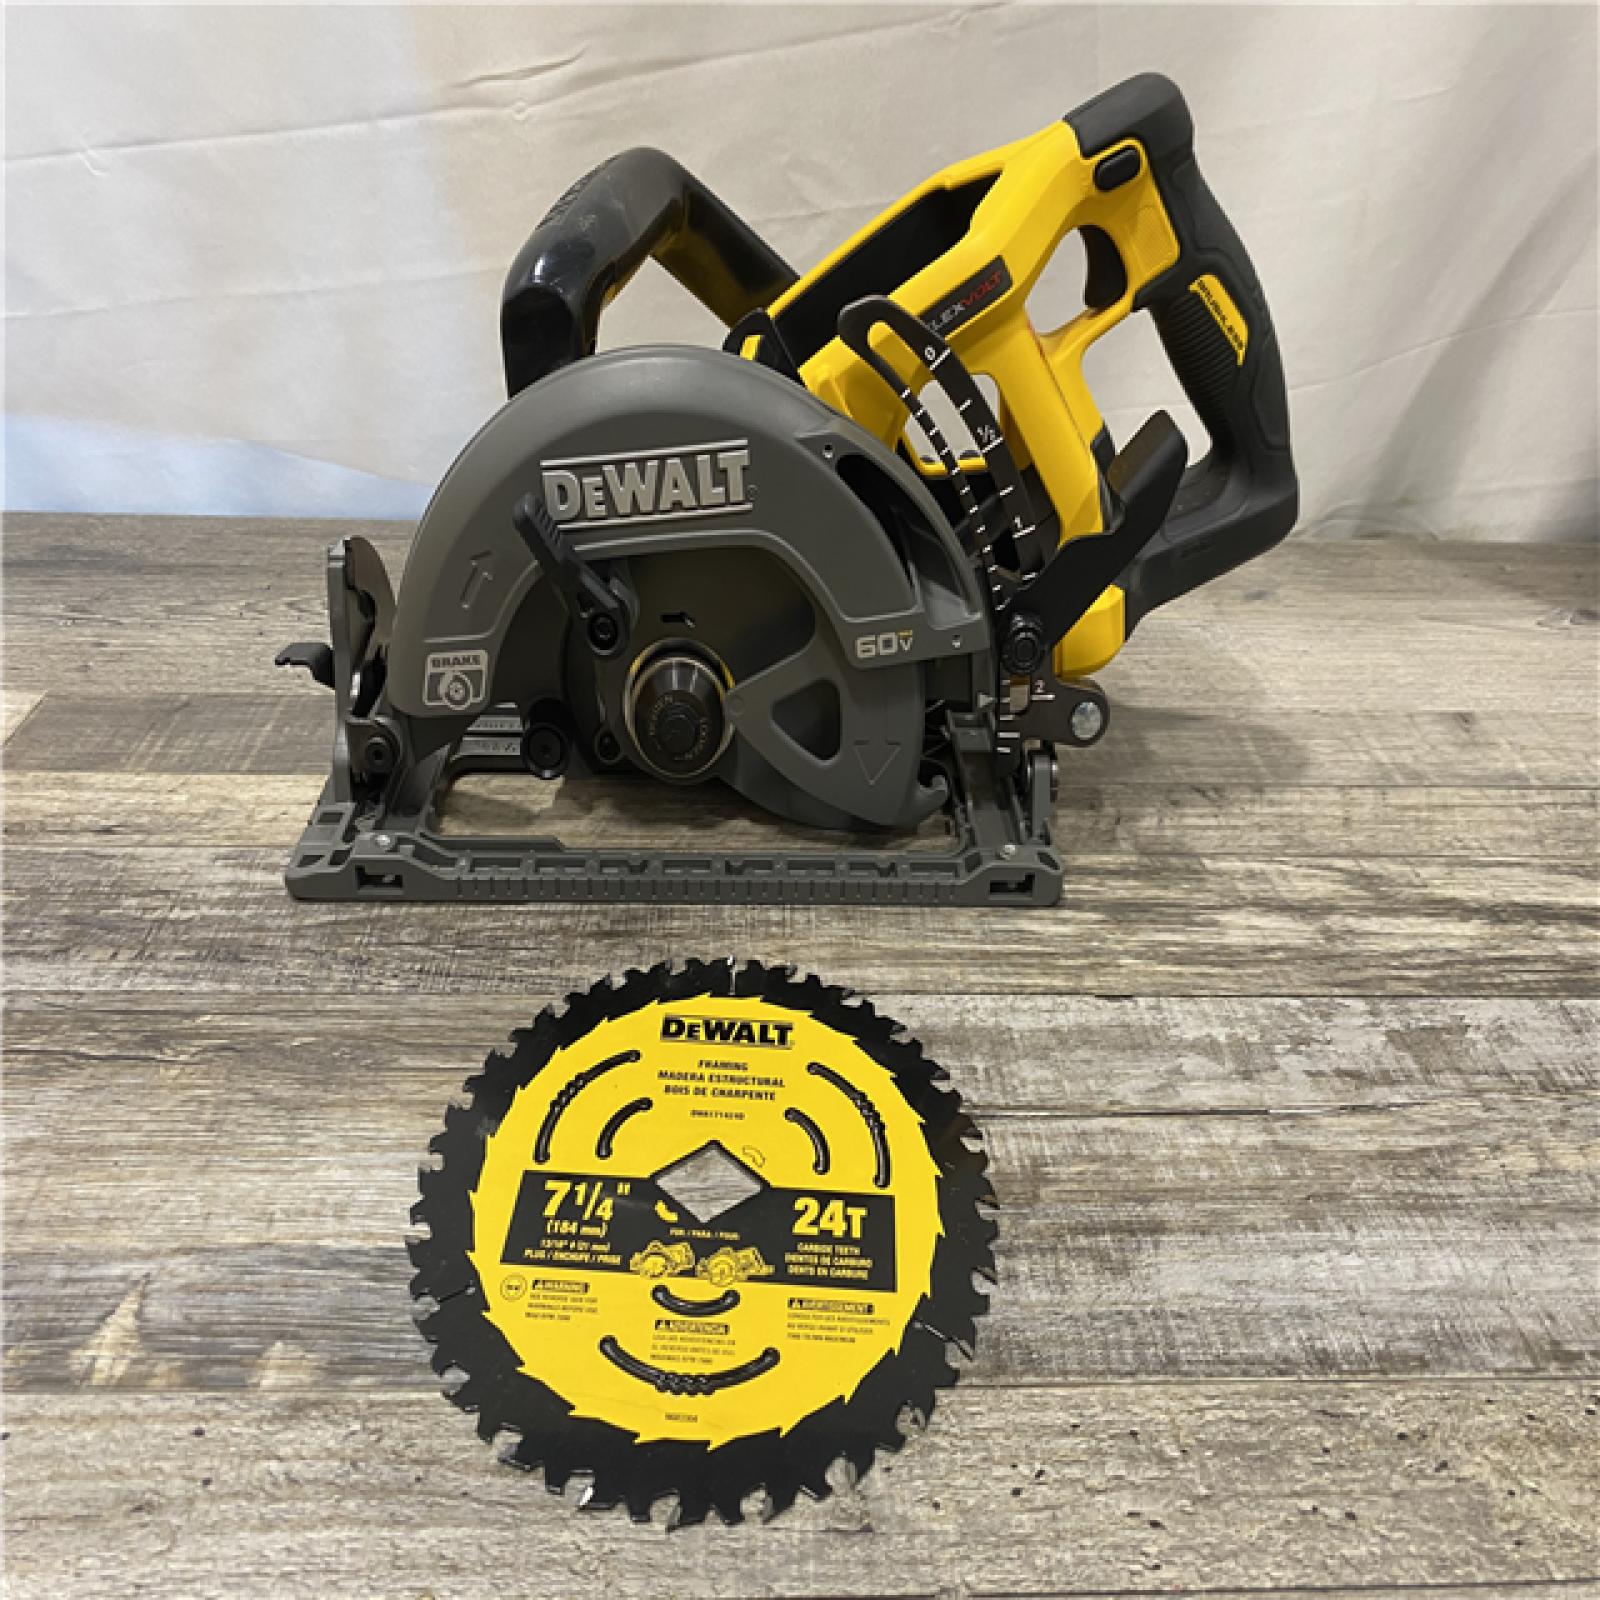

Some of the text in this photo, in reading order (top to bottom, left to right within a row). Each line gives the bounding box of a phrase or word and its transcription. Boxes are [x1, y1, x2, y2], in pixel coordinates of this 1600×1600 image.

[925, 346, 935, 360] 0
[432, 655, 480, 668] BRAKE
[697, 1059, 748, 1071] FRAMING
[657, 1069, 785, 1088] MADERA ESTRUCTURAL
[664, 1084, 776, 1101] BOIS DE CHARPENTE
[792, 1197, 868, 1239] 24T
[546, 1219, 608, 1239] (184 mm)
